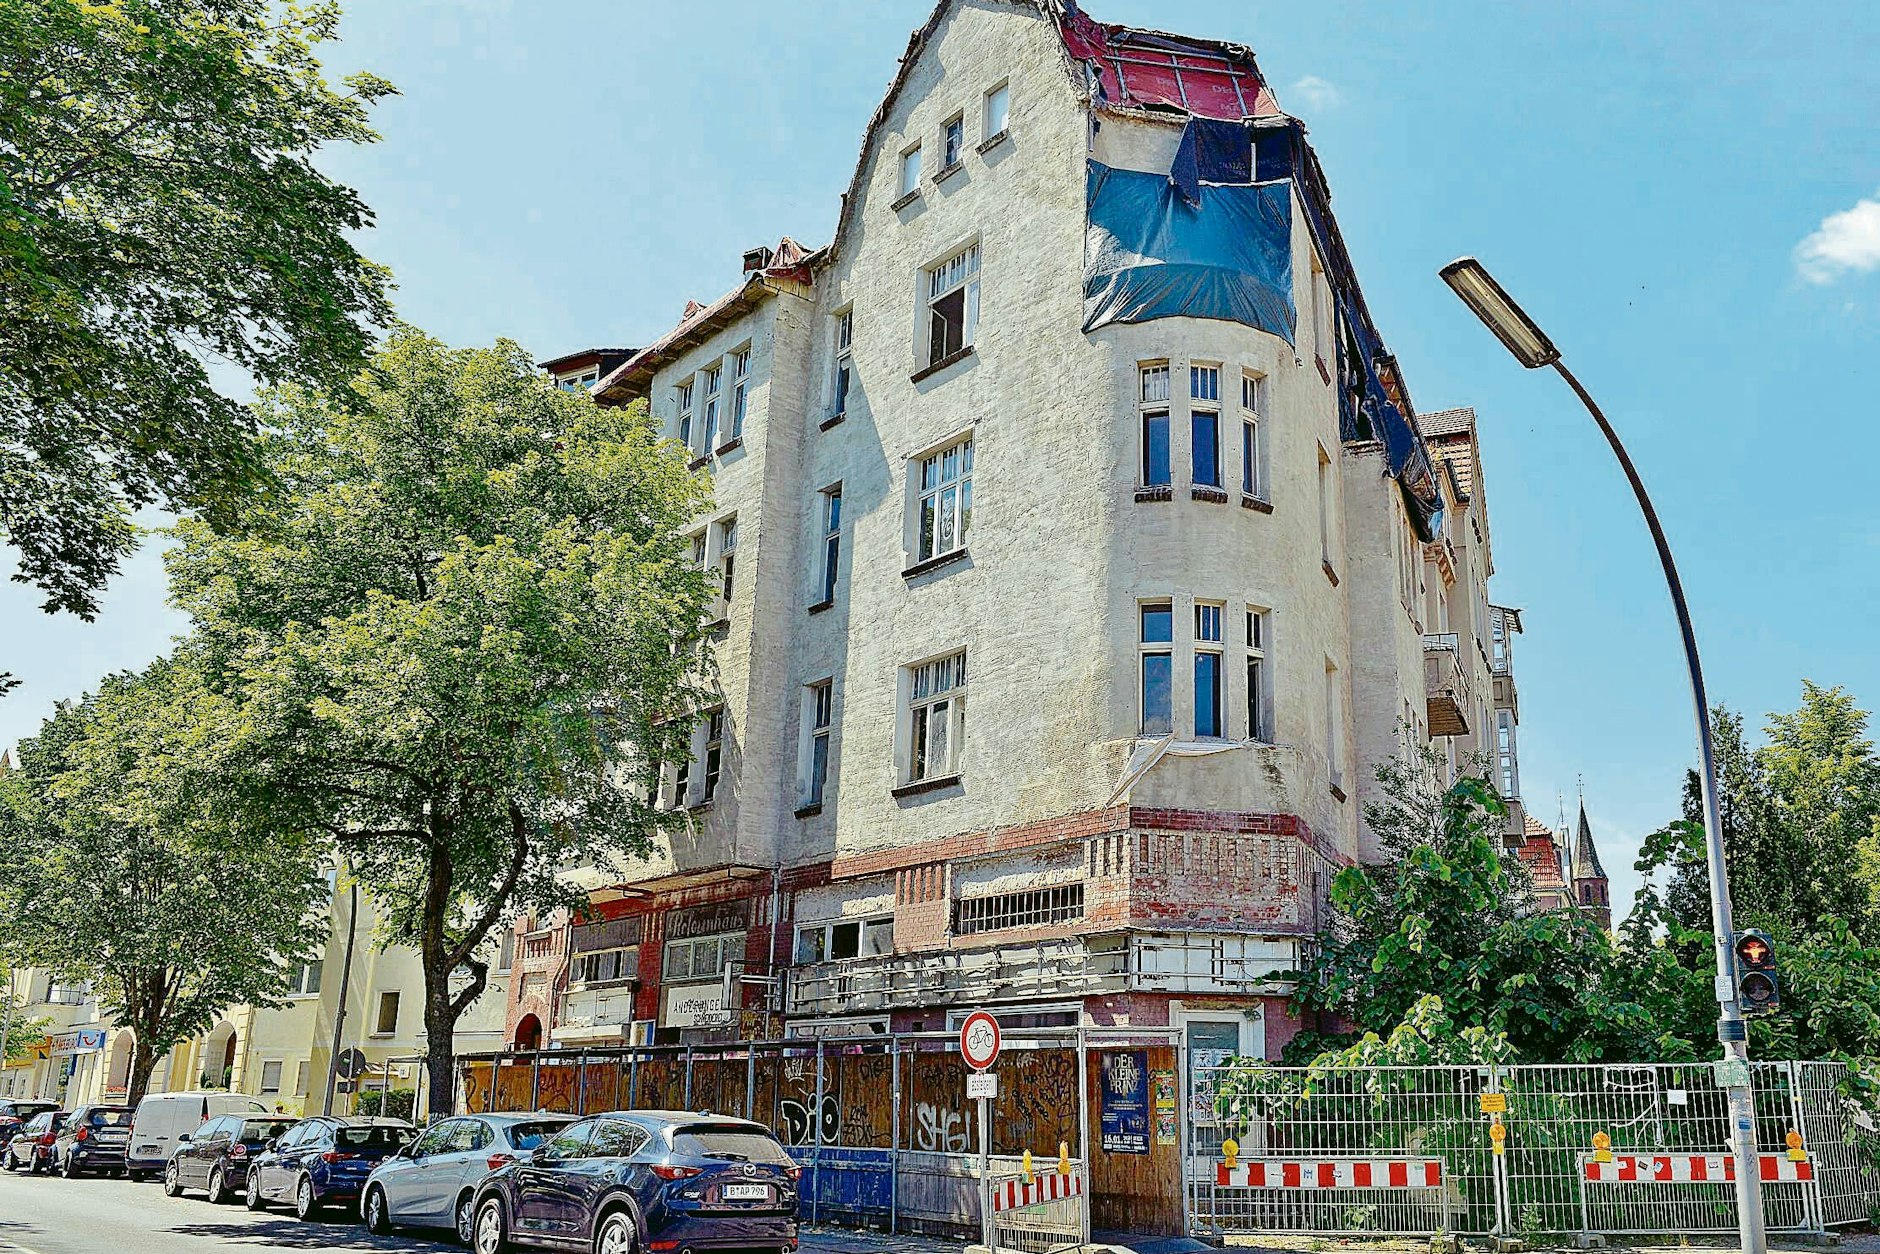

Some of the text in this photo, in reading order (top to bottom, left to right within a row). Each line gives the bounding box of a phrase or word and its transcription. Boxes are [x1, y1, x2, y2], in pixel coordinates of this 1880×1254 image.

[1114, 1054, 1134, 1069] DER
[1108, 1068, 1140, 1081] KLEINE
[1110, 1080, 1138, 1097] PRINZ
[740, 1186, 750, 1196] AP
